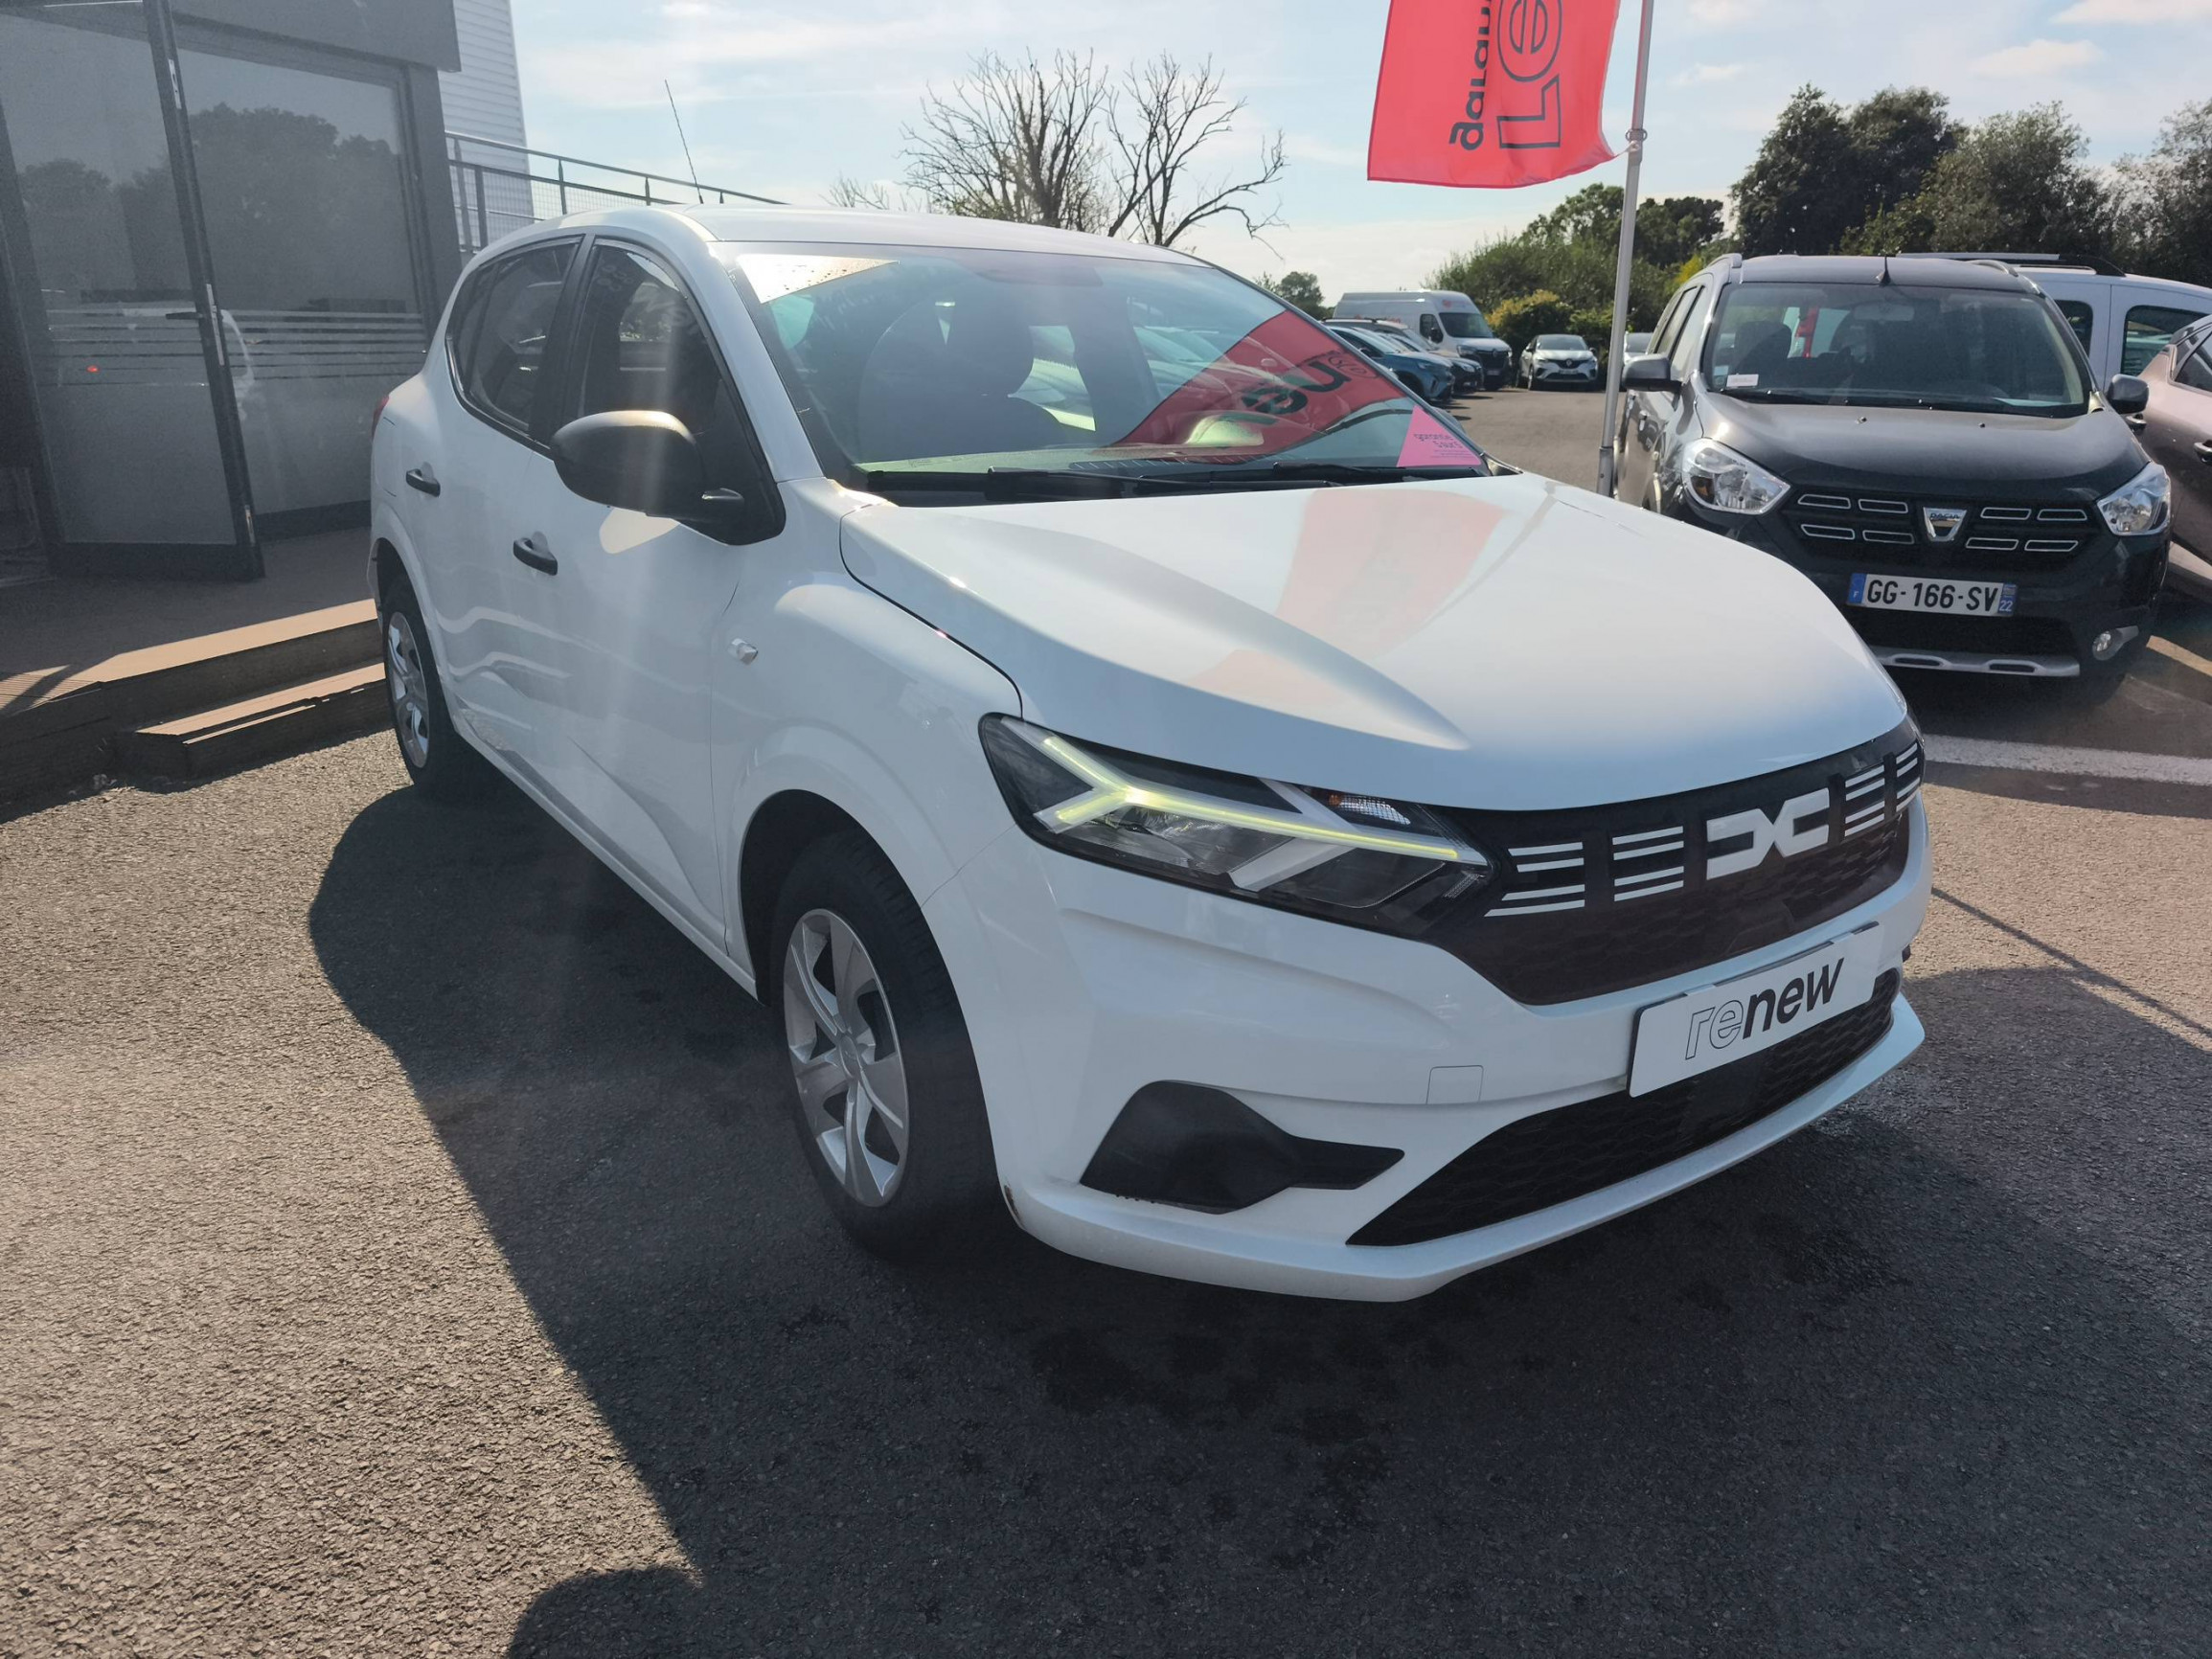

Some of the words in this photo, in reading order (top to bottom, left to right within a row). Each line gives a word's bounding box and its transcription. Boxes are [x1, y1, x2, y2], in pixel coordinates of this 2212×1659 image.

[1867, 580, 1998, 612] GG-166-SV
[1998, 600, 2014, 612] 22
[1685, 958, 1845, 1060] renew
